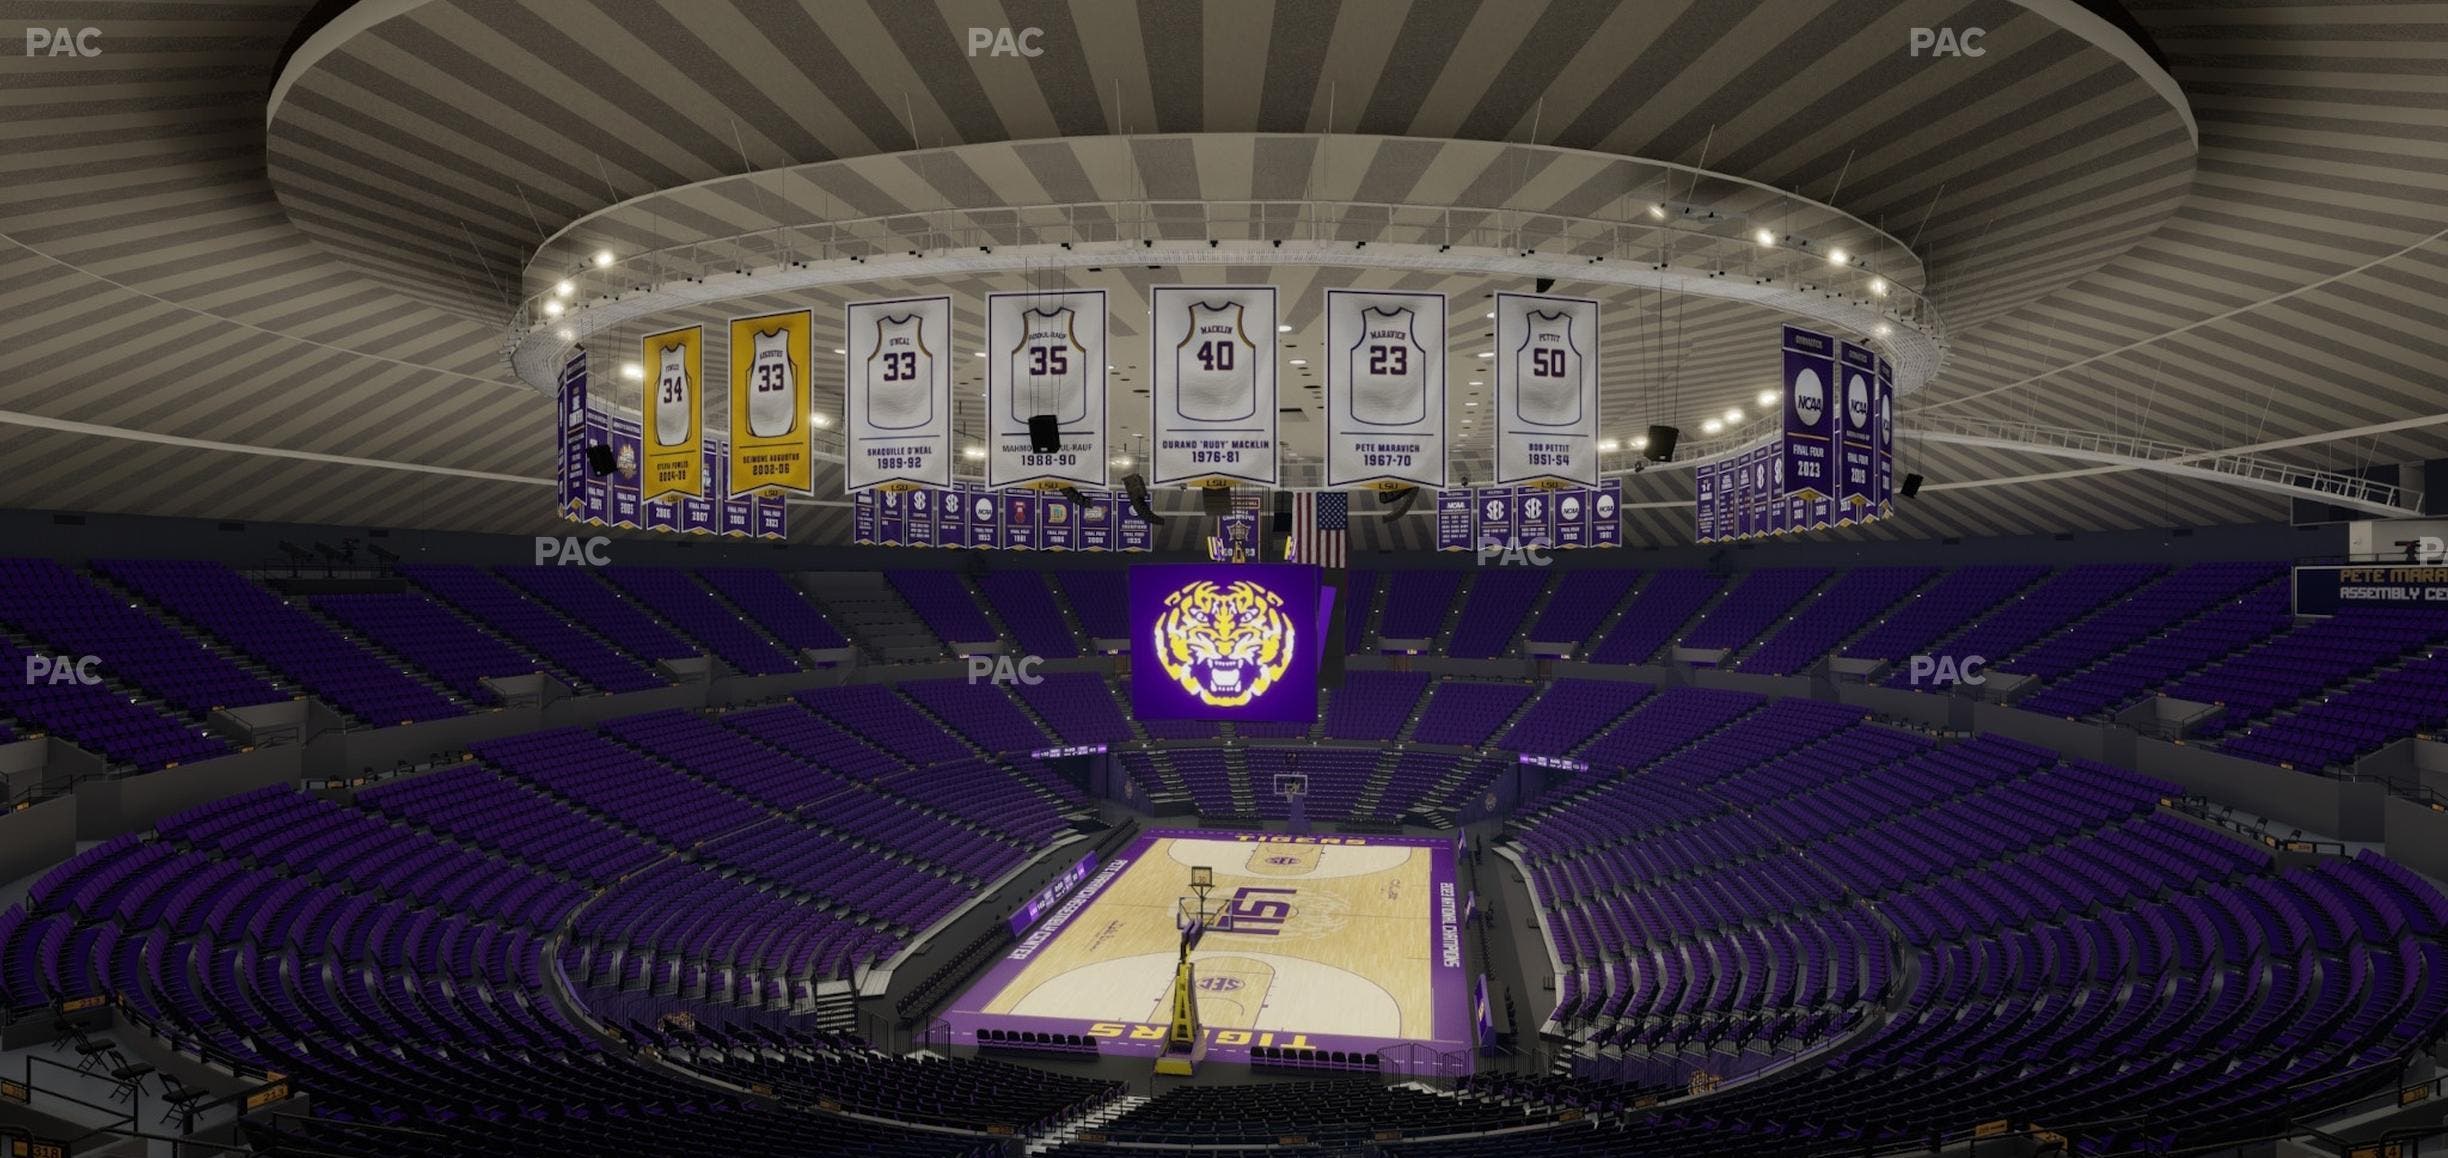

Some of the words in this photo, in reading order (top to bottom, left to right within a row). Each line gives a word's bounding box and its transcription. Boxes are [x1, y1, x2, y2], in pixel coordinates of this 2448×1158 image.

[1030, 346, 1067, 375] 35
[1197, 341, 1233, 371] 40
[1370, 345, 1407, 375] 23
[1533, 347, 1565, 378] 50
[883, 351, 916, 381] 33
[758, 363, 784, 392] 33
[663, 376, 682, 404] 34
[1798, 395, 1822, 411] NCAA
[1851, 400, 1867, 414] NCAA
[1002, 444, 1032, 453] MAHMO
[1163, 440, 1197, 449] DURAND
[1231, 440, 1269, 449] MACKLIN
[1355, 443, 1375, 452] PETE
[1378, 444, 1420, 453] MARAVICH
[1545, 443, 1569, 453] PETTIT
[1793, 444, 1808, 456] FINAL
[1809, 446, 1824, 458] FOUR
[878, 456, 922, 469] 1989-92
[1021, 454, 1076, 466] 1988-90
[1192, 451, 1239, 463] 1976-81
[1364, 454, 1411, 467] 1967-70
[1528, 453, 1570, 466] 1951-54
[1797, 460, 1820, 478] 2023
[1486, 500, 1504, 520] SEC
[2341, 569, 2385, 583] PETE
[2341, 587, 2420, 600] ASSEMBLY
[2425, 587, 2448, 601] CE
[1235, 835, 1366, 846] TIGERS
[1210, 887, 1297, 936] LSU
[1199, 976, 1241, 992] SEC
[1087, 1022, 1317, 1050] TIGRS
